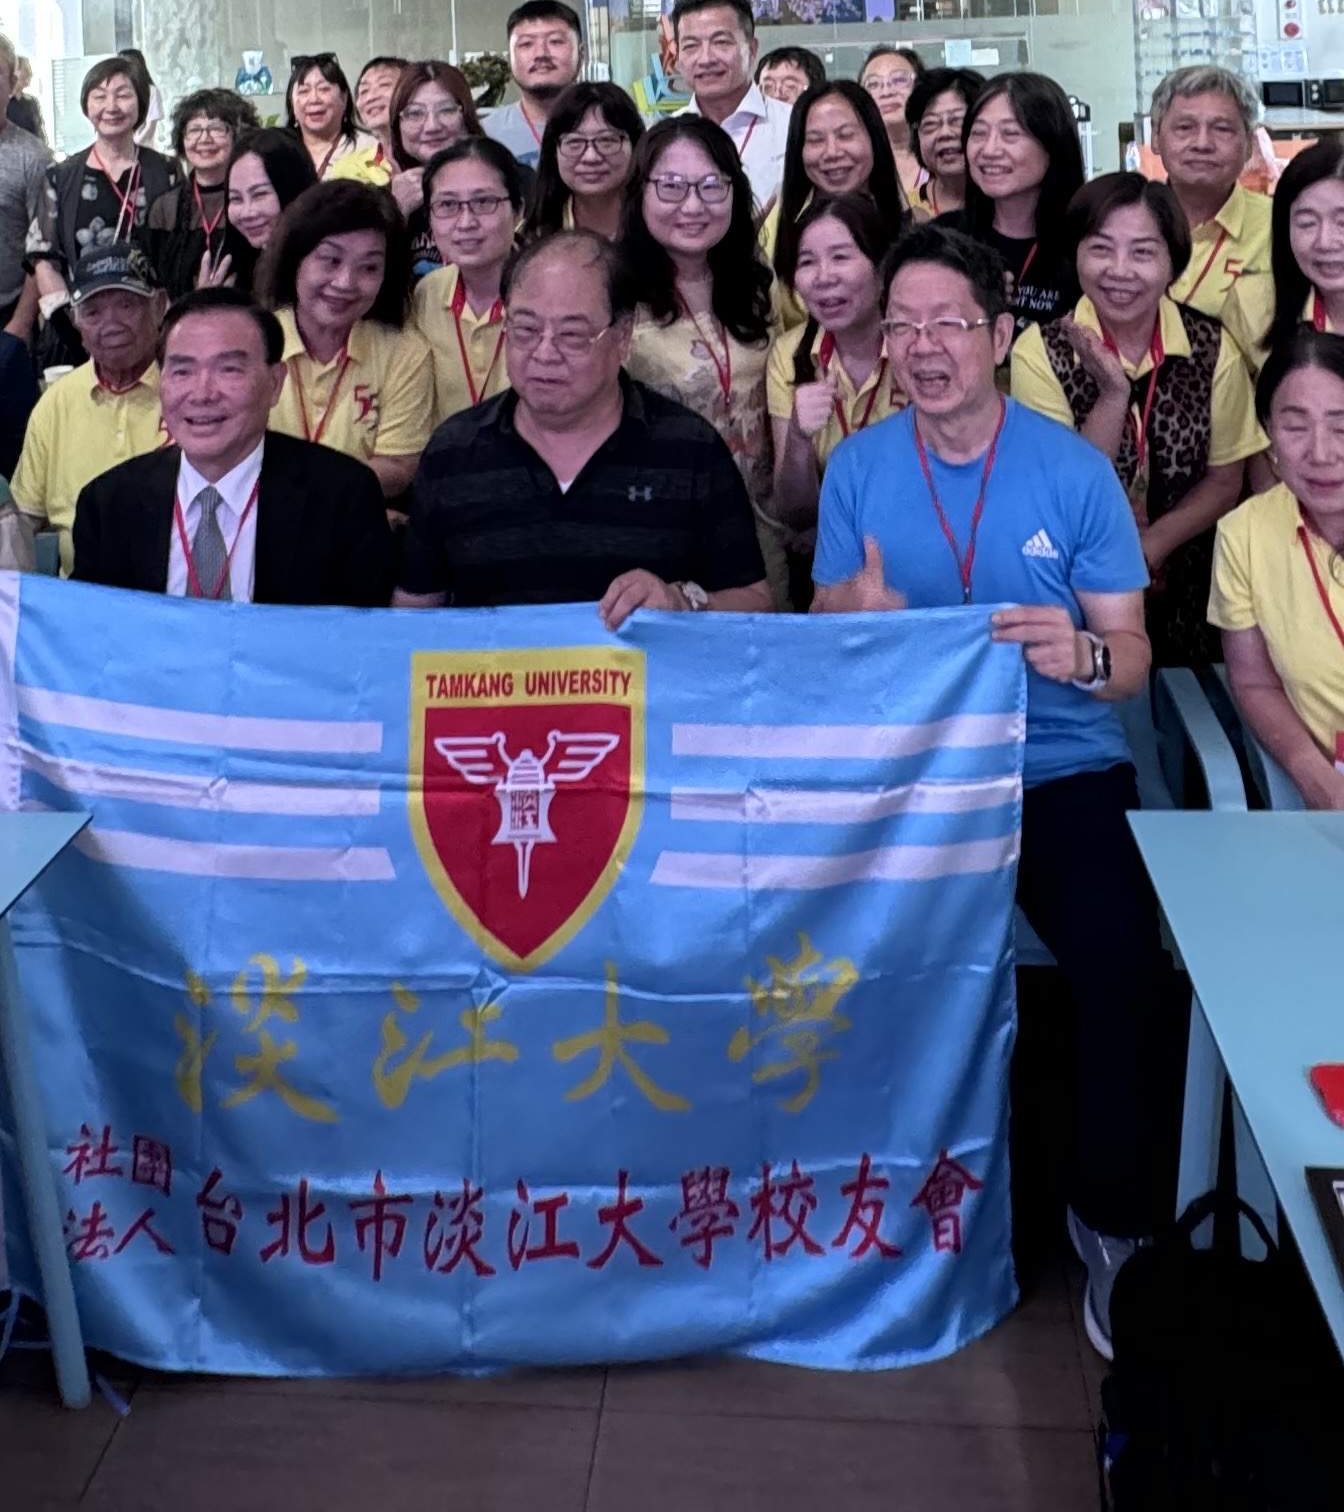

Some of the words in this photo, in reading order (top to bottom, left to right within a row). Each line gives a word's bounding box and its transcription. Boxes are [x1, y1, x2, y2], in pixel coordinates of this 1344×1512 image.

[1018, 285, 1036, 296] YOU
[1040, 289, 1059, 300] ARE
[1029, 298, 1054, 311] NOW
[426, 672, 513, 699] TAMKANG
[525, 669, 631, 696] UNIVERSITY
[175, 931, 858, 1123] 淡江大學
[64, 1122, 171, 1198] 社團
[63, 1200, 175, 1262] 法人
[196, 1148, 984, 1282] 台北市淡江大學校友會
